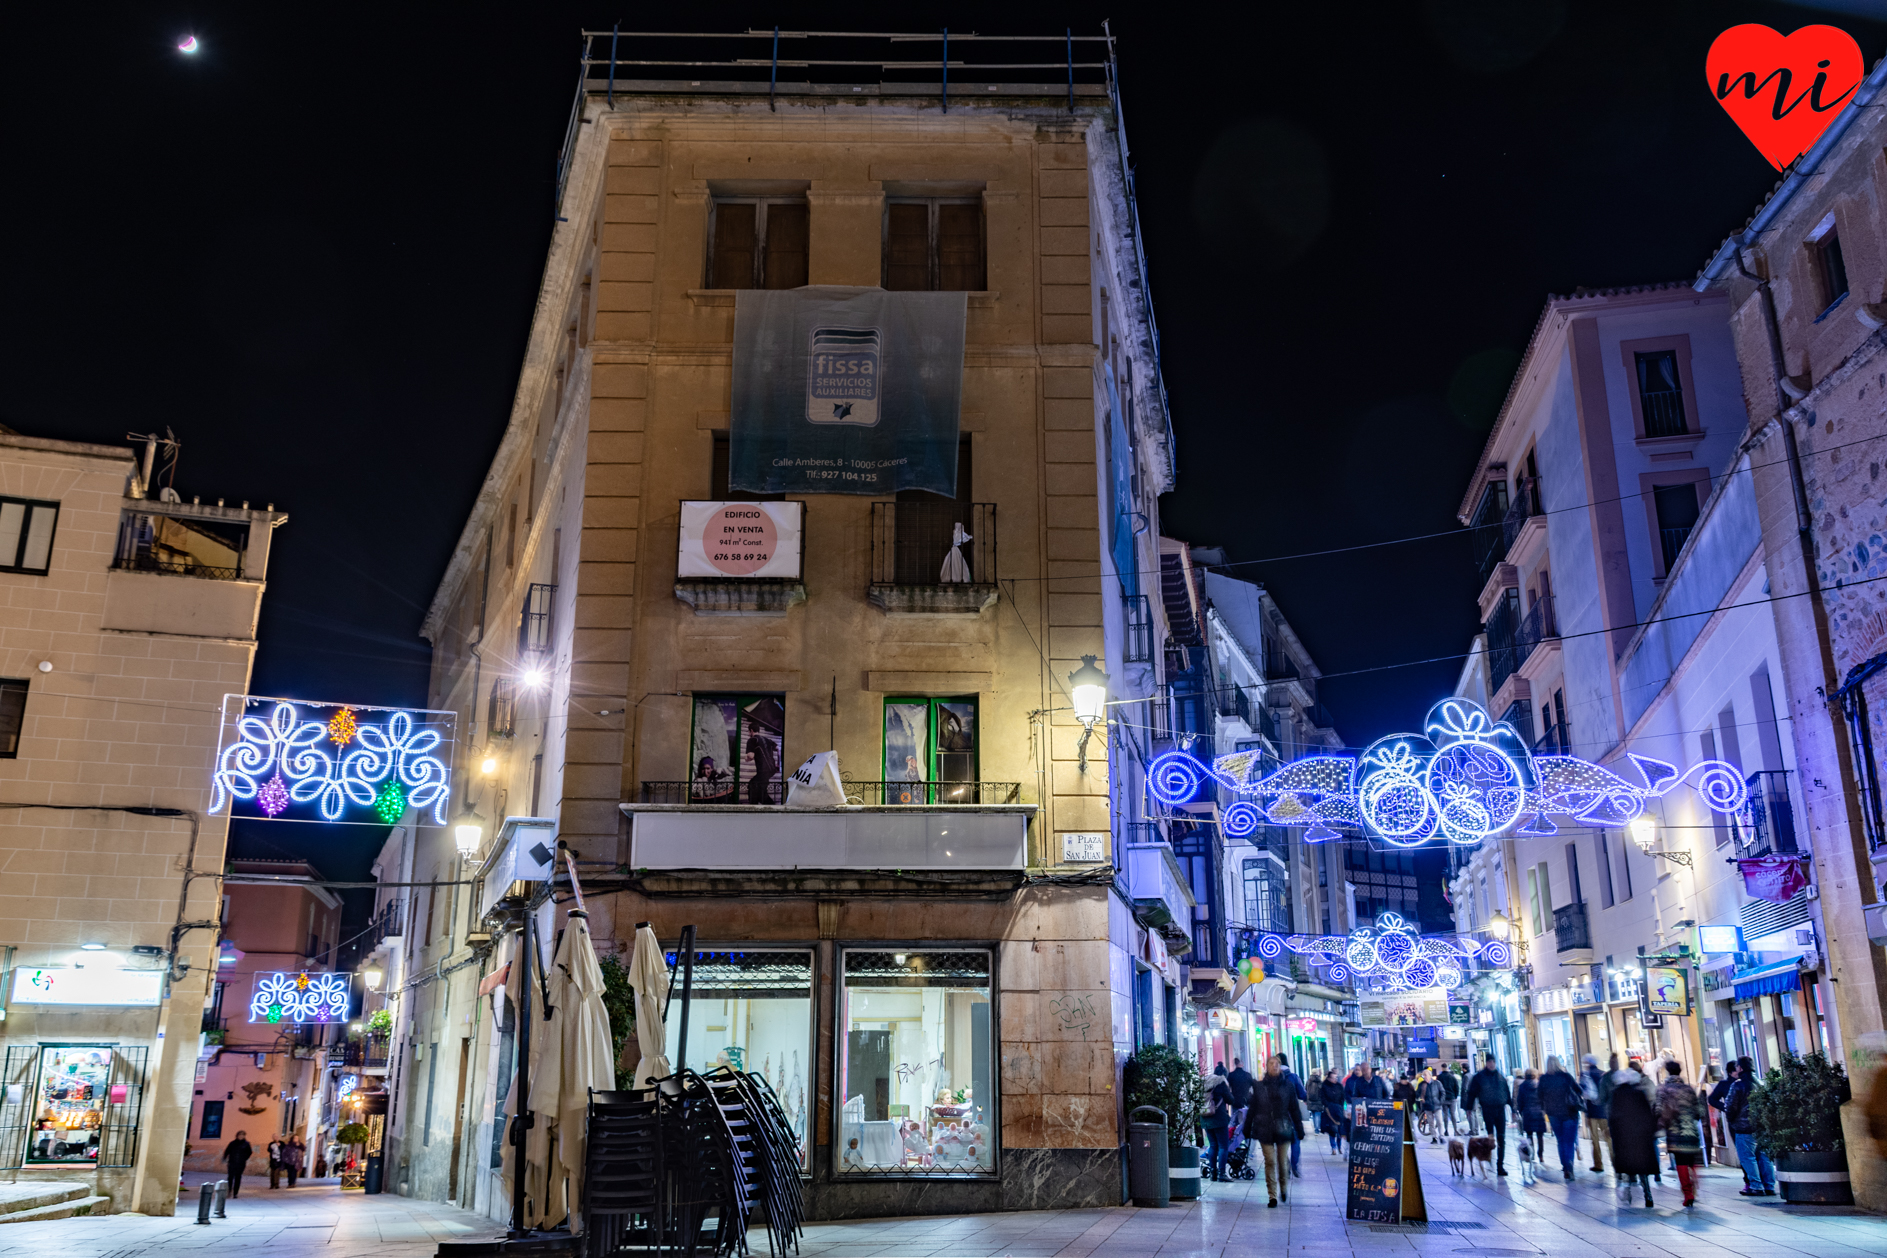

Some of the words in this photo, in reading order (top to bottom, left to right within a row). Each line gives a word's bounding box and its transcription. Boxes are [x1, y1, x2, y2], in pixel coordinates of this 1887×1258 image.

[816, 355, 874, 375] fissa
[816, 377, 872, 388] SERVICIOS
[815, 387, 872, 397] AUXILIARES
[772, 458, 793, 467] Calle
[795, 458, 836, 467] Amberes,
[837, 458, 843, 467] 8
[851, 459, 876, 469] 10005
[877, 456, 908, 468] Cáceres
[821, 471, 839, 479] 927
[842, 471, 858, 480] 104
[861, 473, 877, 482] 125
[724, 511, 761, 519] EDIFICIO
[723, 526, 735, 534] EN
[737, 526, 764, 534] VENTA
[714, 553, 729, 561] 676
[730, 553, 742, 561] 58
[743, 553, 755, 561] 69
[756, 553, 768, 561] 24
[1077, 835, 1102, 844] PLAZA
[1084, 843, 1094, 851] DE
[1065, 850, 1081, 860] SAN
[1081, 850, 1101, 860] JUAN
[1400, 988, 1434, 996] SOLIDARIO
